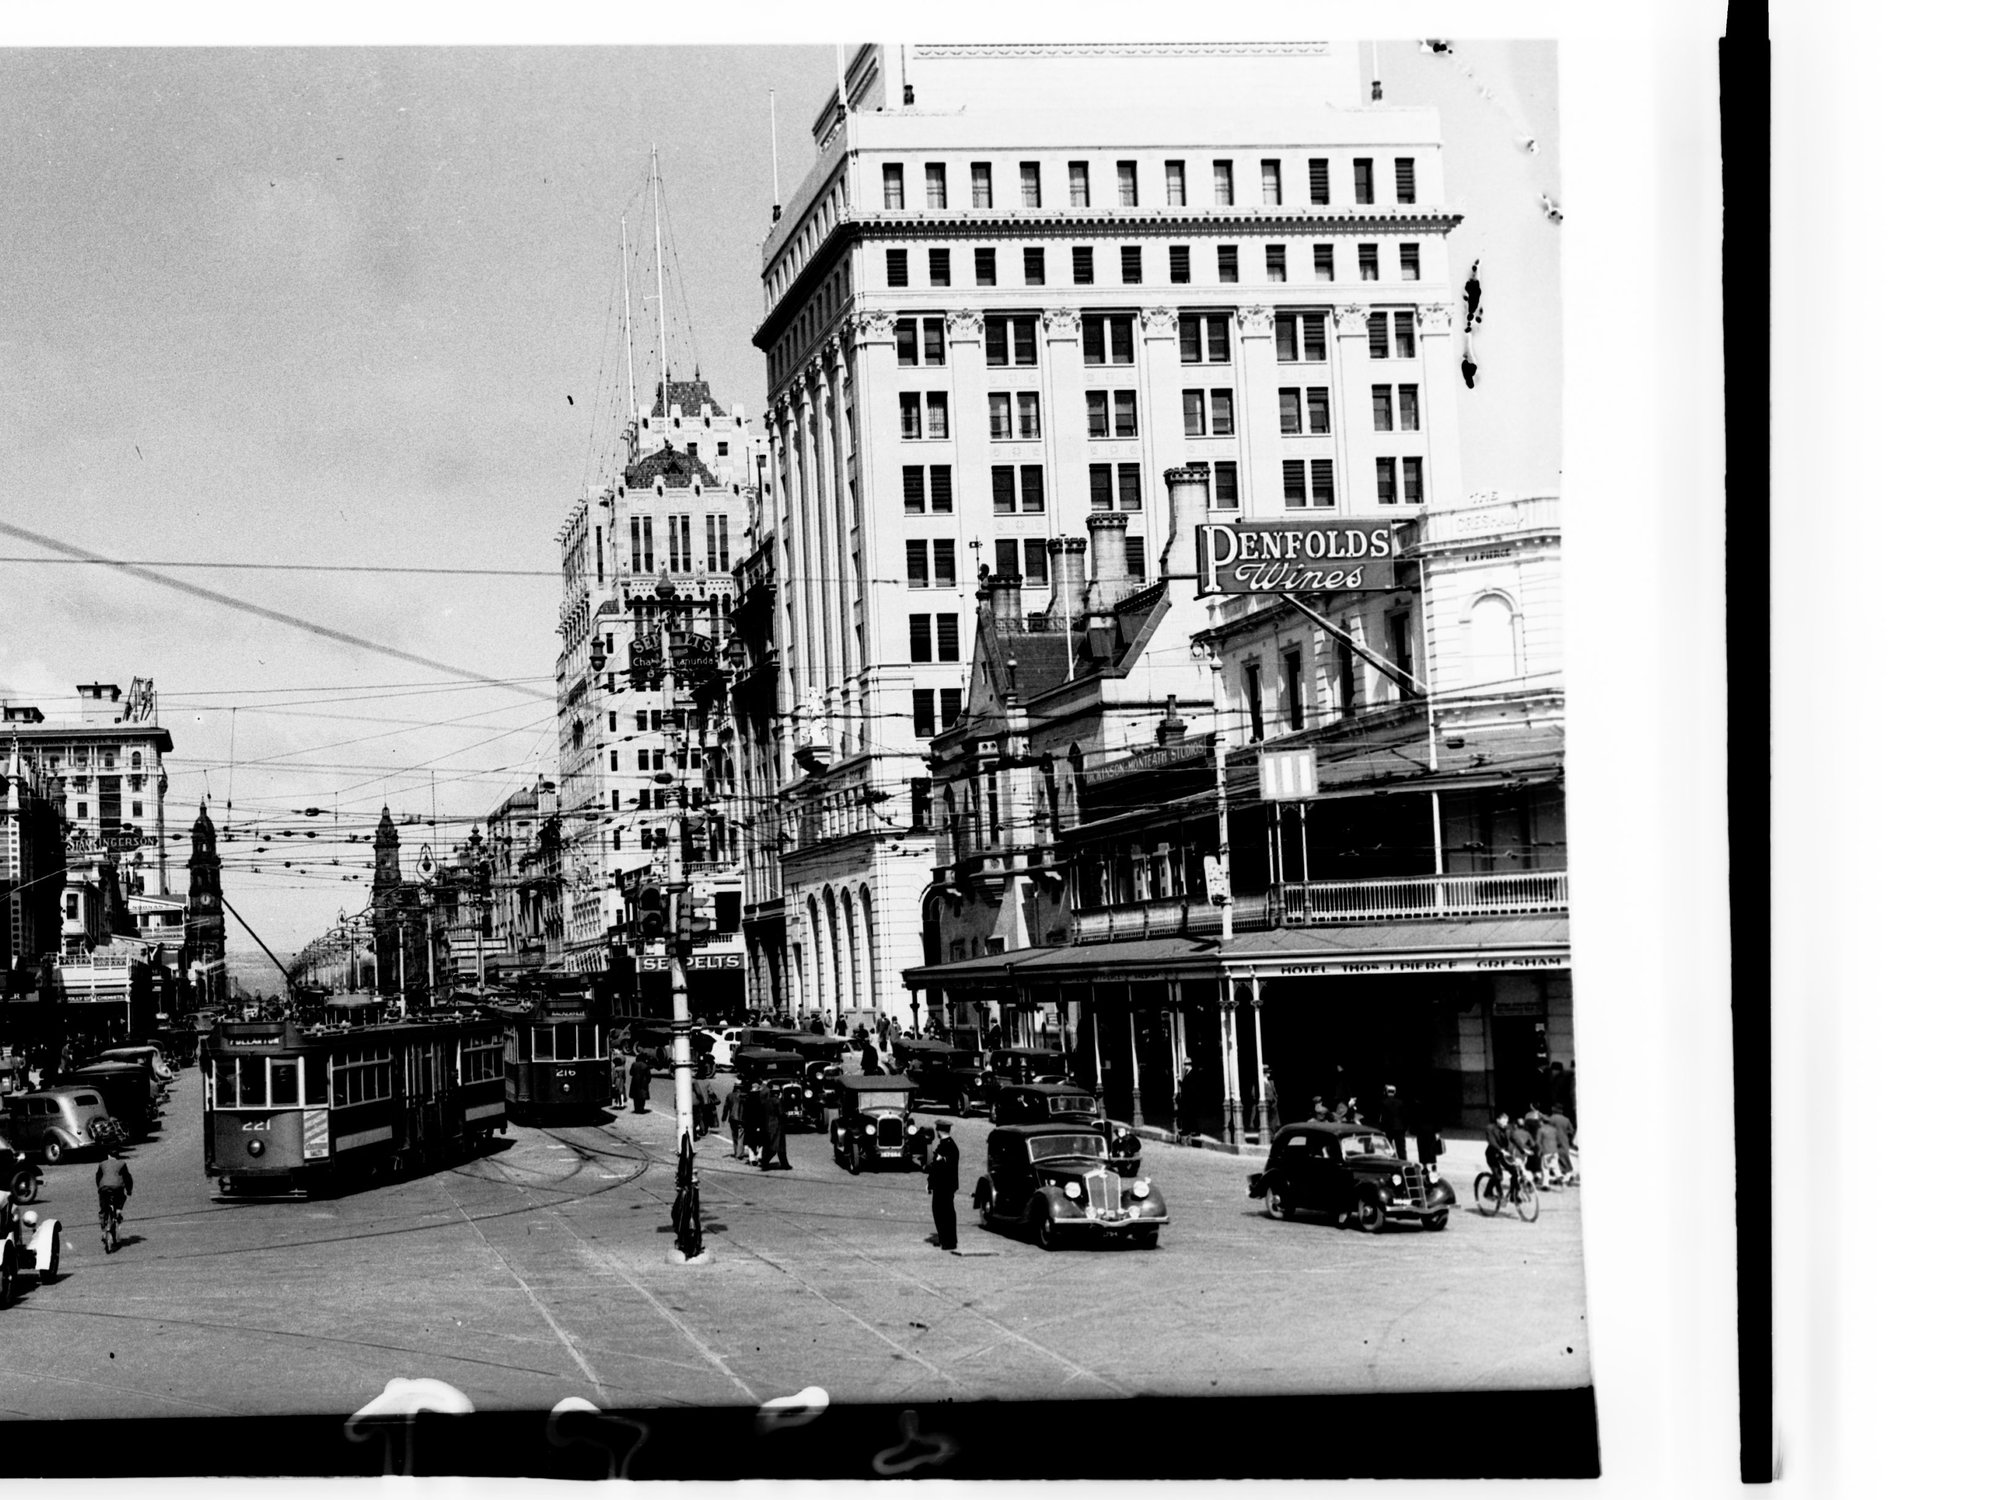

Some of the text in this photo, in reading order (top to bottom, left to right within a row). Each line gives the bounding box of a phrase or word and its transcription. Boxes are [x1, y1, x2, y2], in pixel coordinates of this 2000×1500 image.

[1202, 525, 1390, 592] PENFOLDS
[1235, 562, 1364, 591] Wines
[1171, 740, 1204, 761] STUDIOS
[1281, 964, 1330, 975] HOTEL
[1400, 958, 1457, 971] PIERCE
[1476, 957, 1561, 968] GRESHAM
[556, 1069, 576, 1077] 216
[242, 1119, 271, 1131] 221
